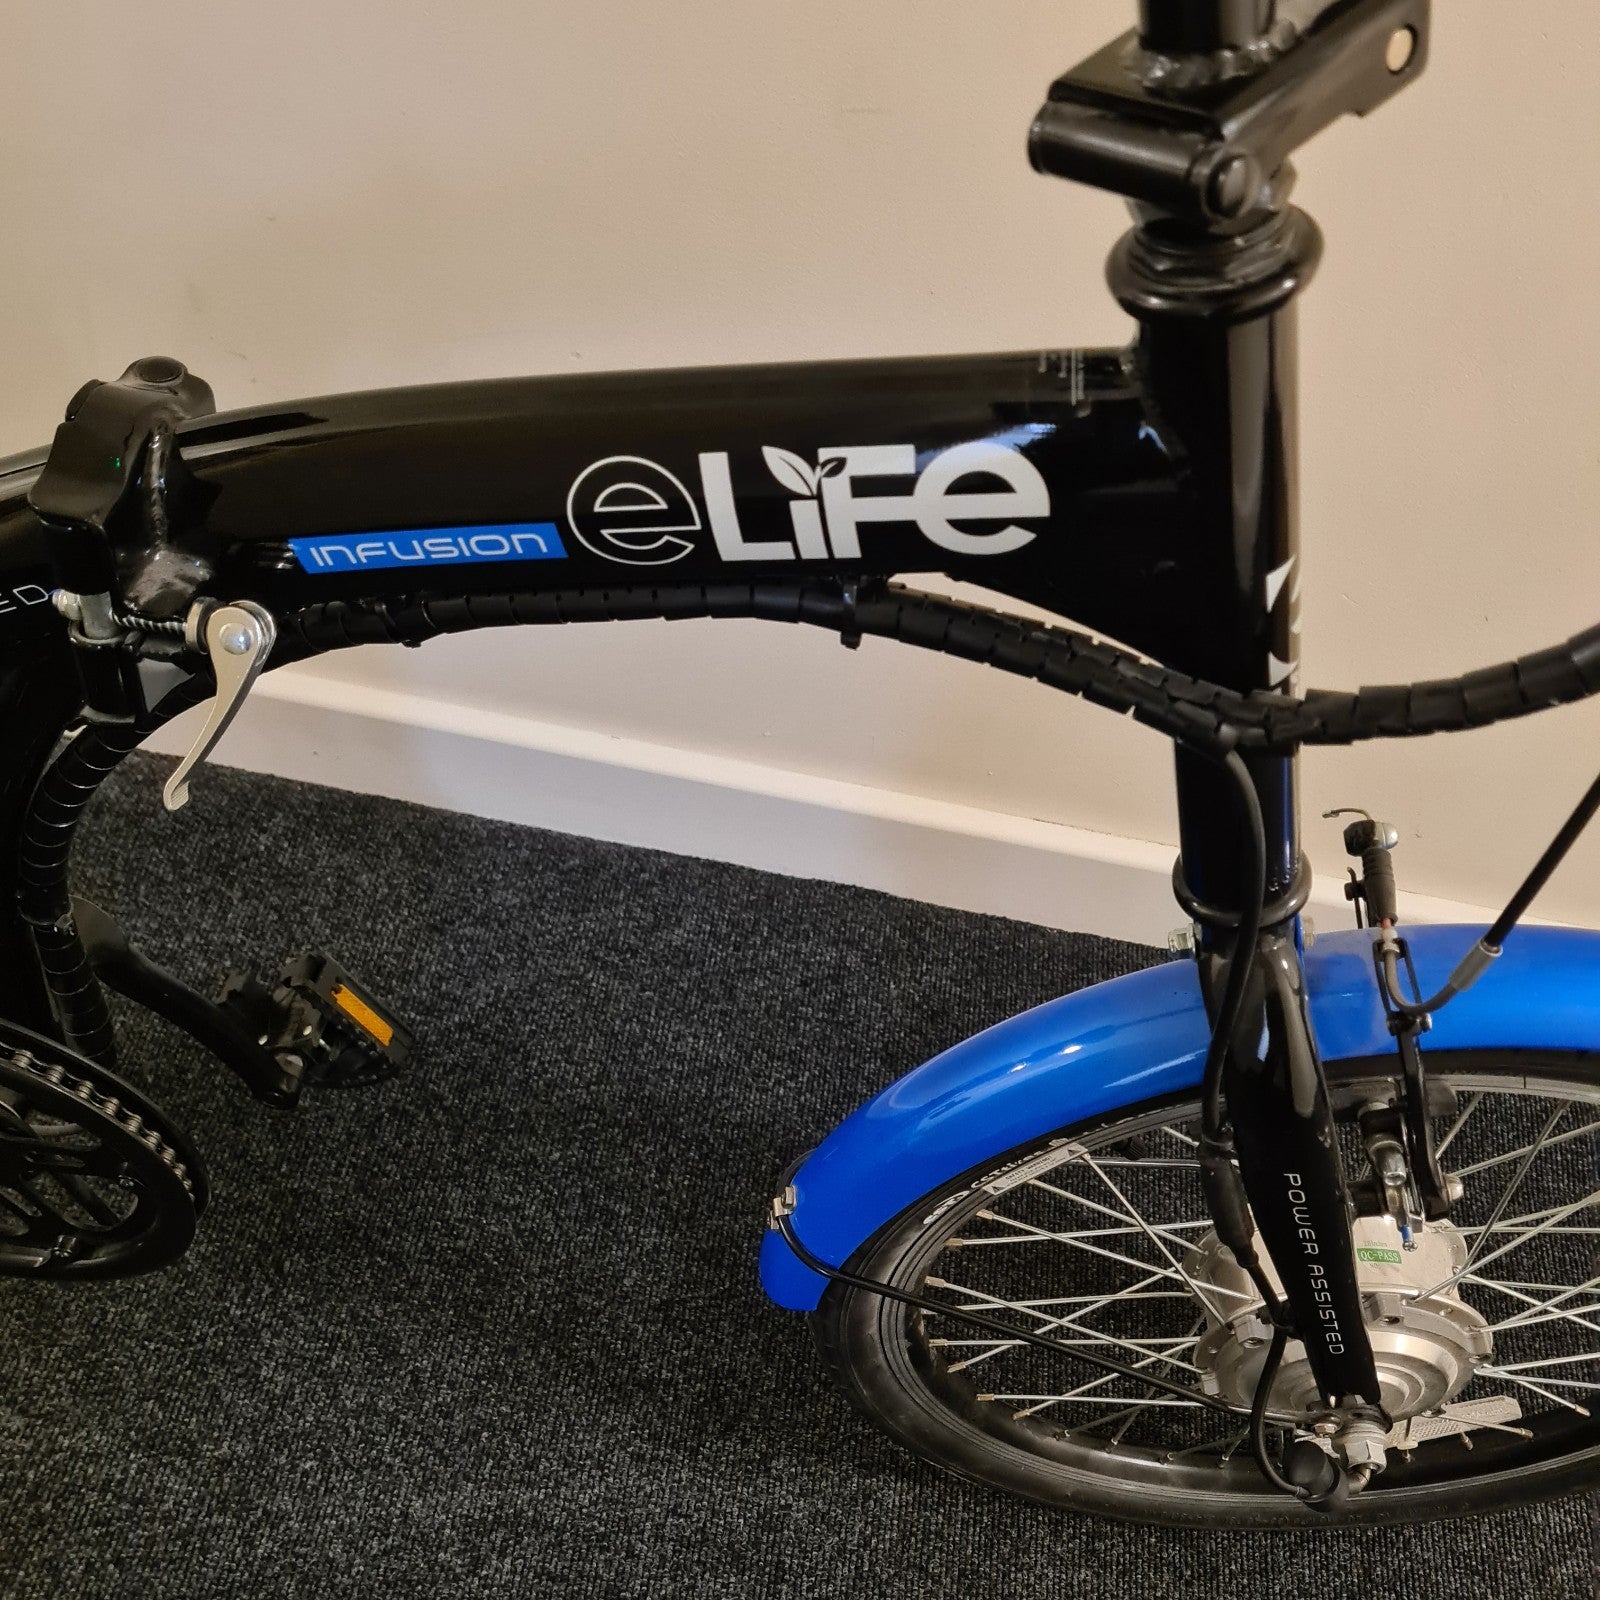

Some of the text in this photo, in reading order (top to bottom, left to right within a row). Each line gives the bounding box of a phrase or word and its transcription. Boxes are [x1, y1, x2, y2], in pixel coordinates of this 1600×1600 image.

[309, 532, 548, 567] INFUSION
[1283, 1172, 1345, 1356] POWER ASSISTED
[1360, 1250, 1400, 1262] QC-PASS
